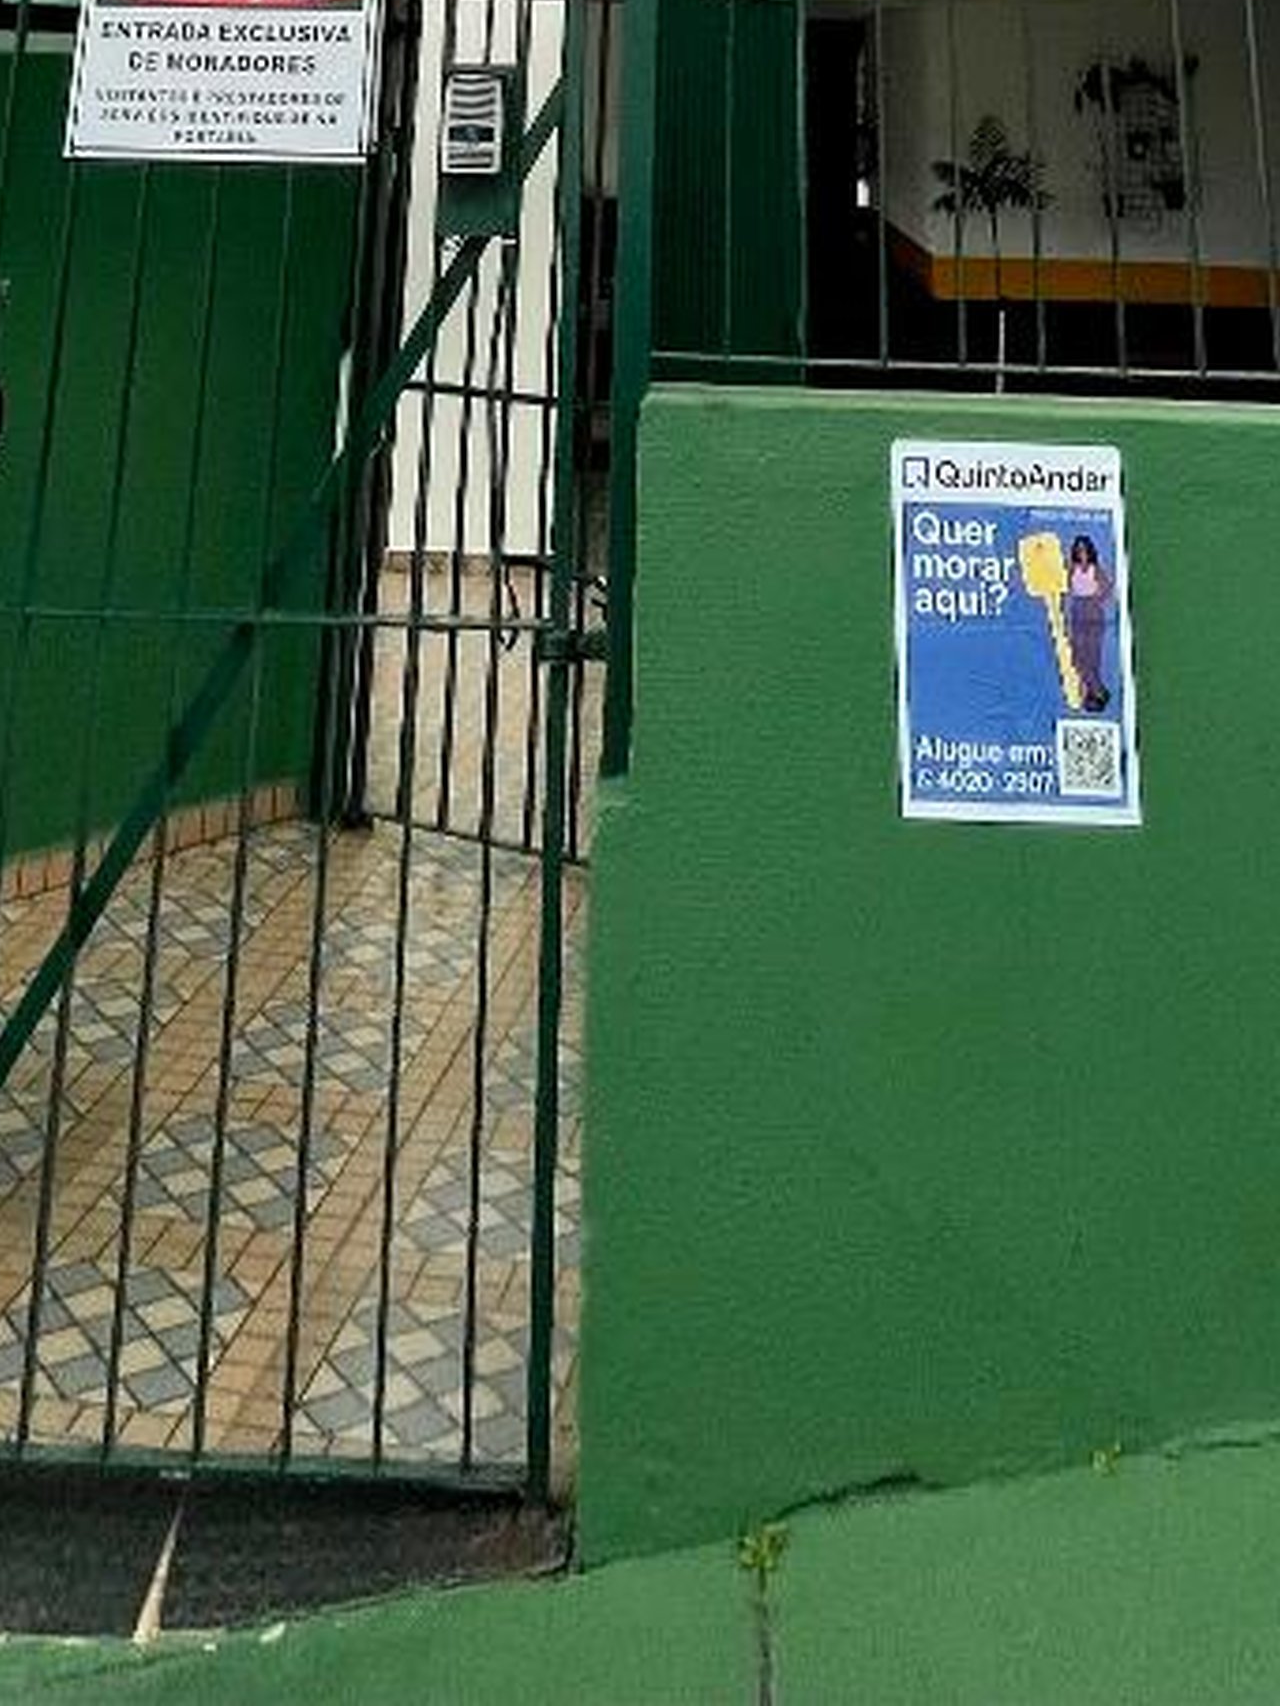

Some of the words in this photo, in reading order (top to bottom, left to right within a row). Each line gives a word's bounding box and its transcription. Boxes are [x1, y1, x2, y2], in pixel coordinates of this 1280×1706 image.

[101, 21, 211, 40] ENTRADA
[219, 24, 351, 43] EXCLUSIVA
[128, 52, 158, 71] DE
[167, 52, 317, 76] MORADORES
[935, 460, 1113, 492] QuintoAndar
[912, 511, 998, 545] Quer
[913, 553, 1015, 582] morar
[915, 583, 1008, 623] aqui?
[917, 735, 1004, 769] Alugue
